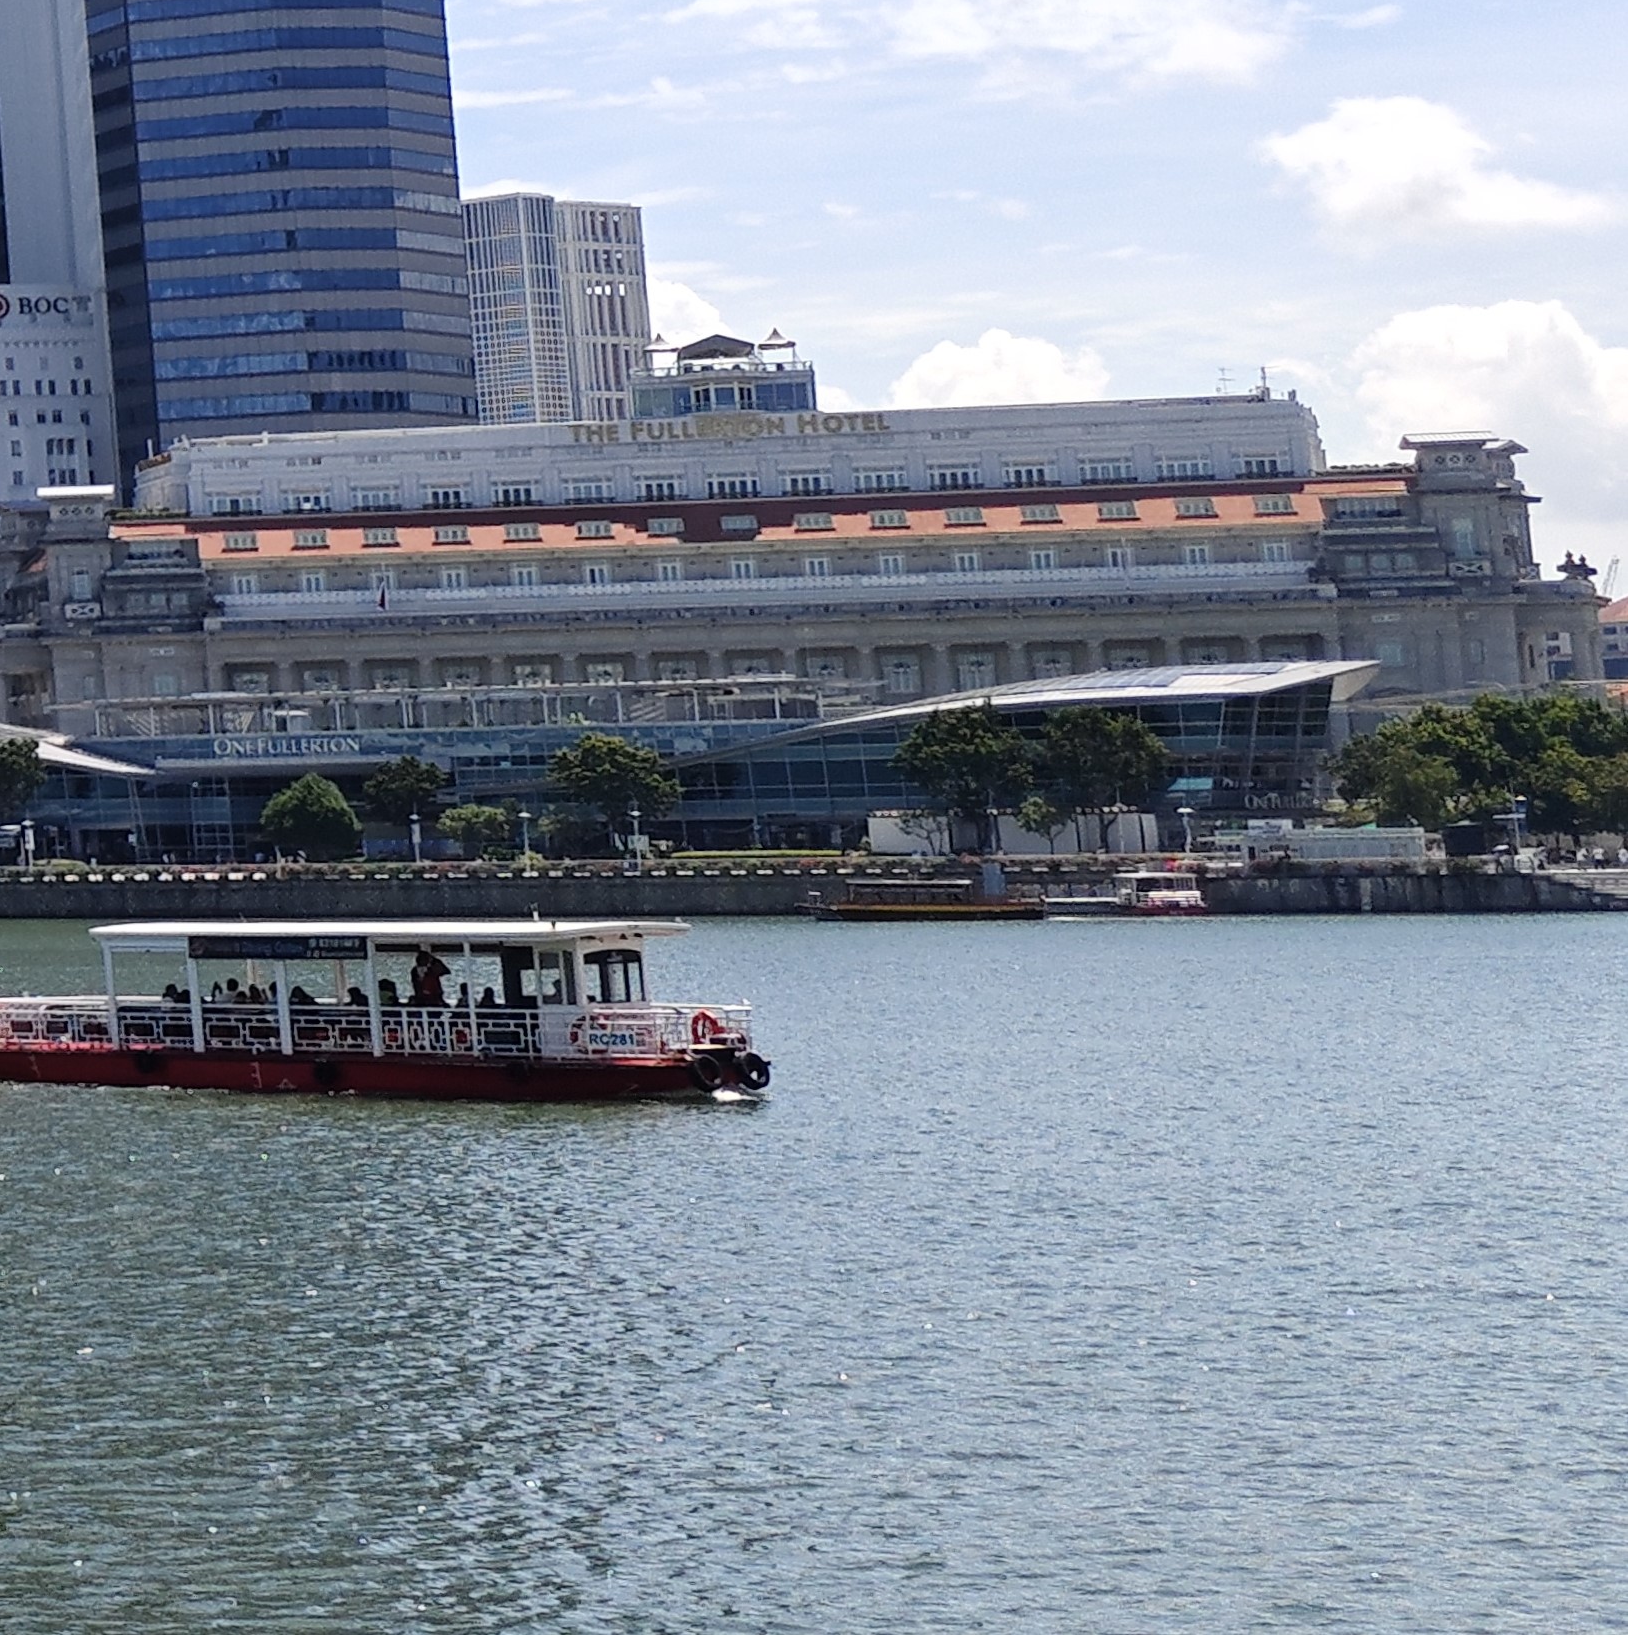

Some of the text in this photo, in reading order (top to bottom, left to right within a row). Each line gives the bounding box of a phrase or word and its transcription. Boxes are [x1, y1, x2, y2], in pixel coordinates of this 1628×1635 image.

[18, 296, 69, 314] BOC
[571, 413, 890, 442] THE FULLERTON HOTEL
